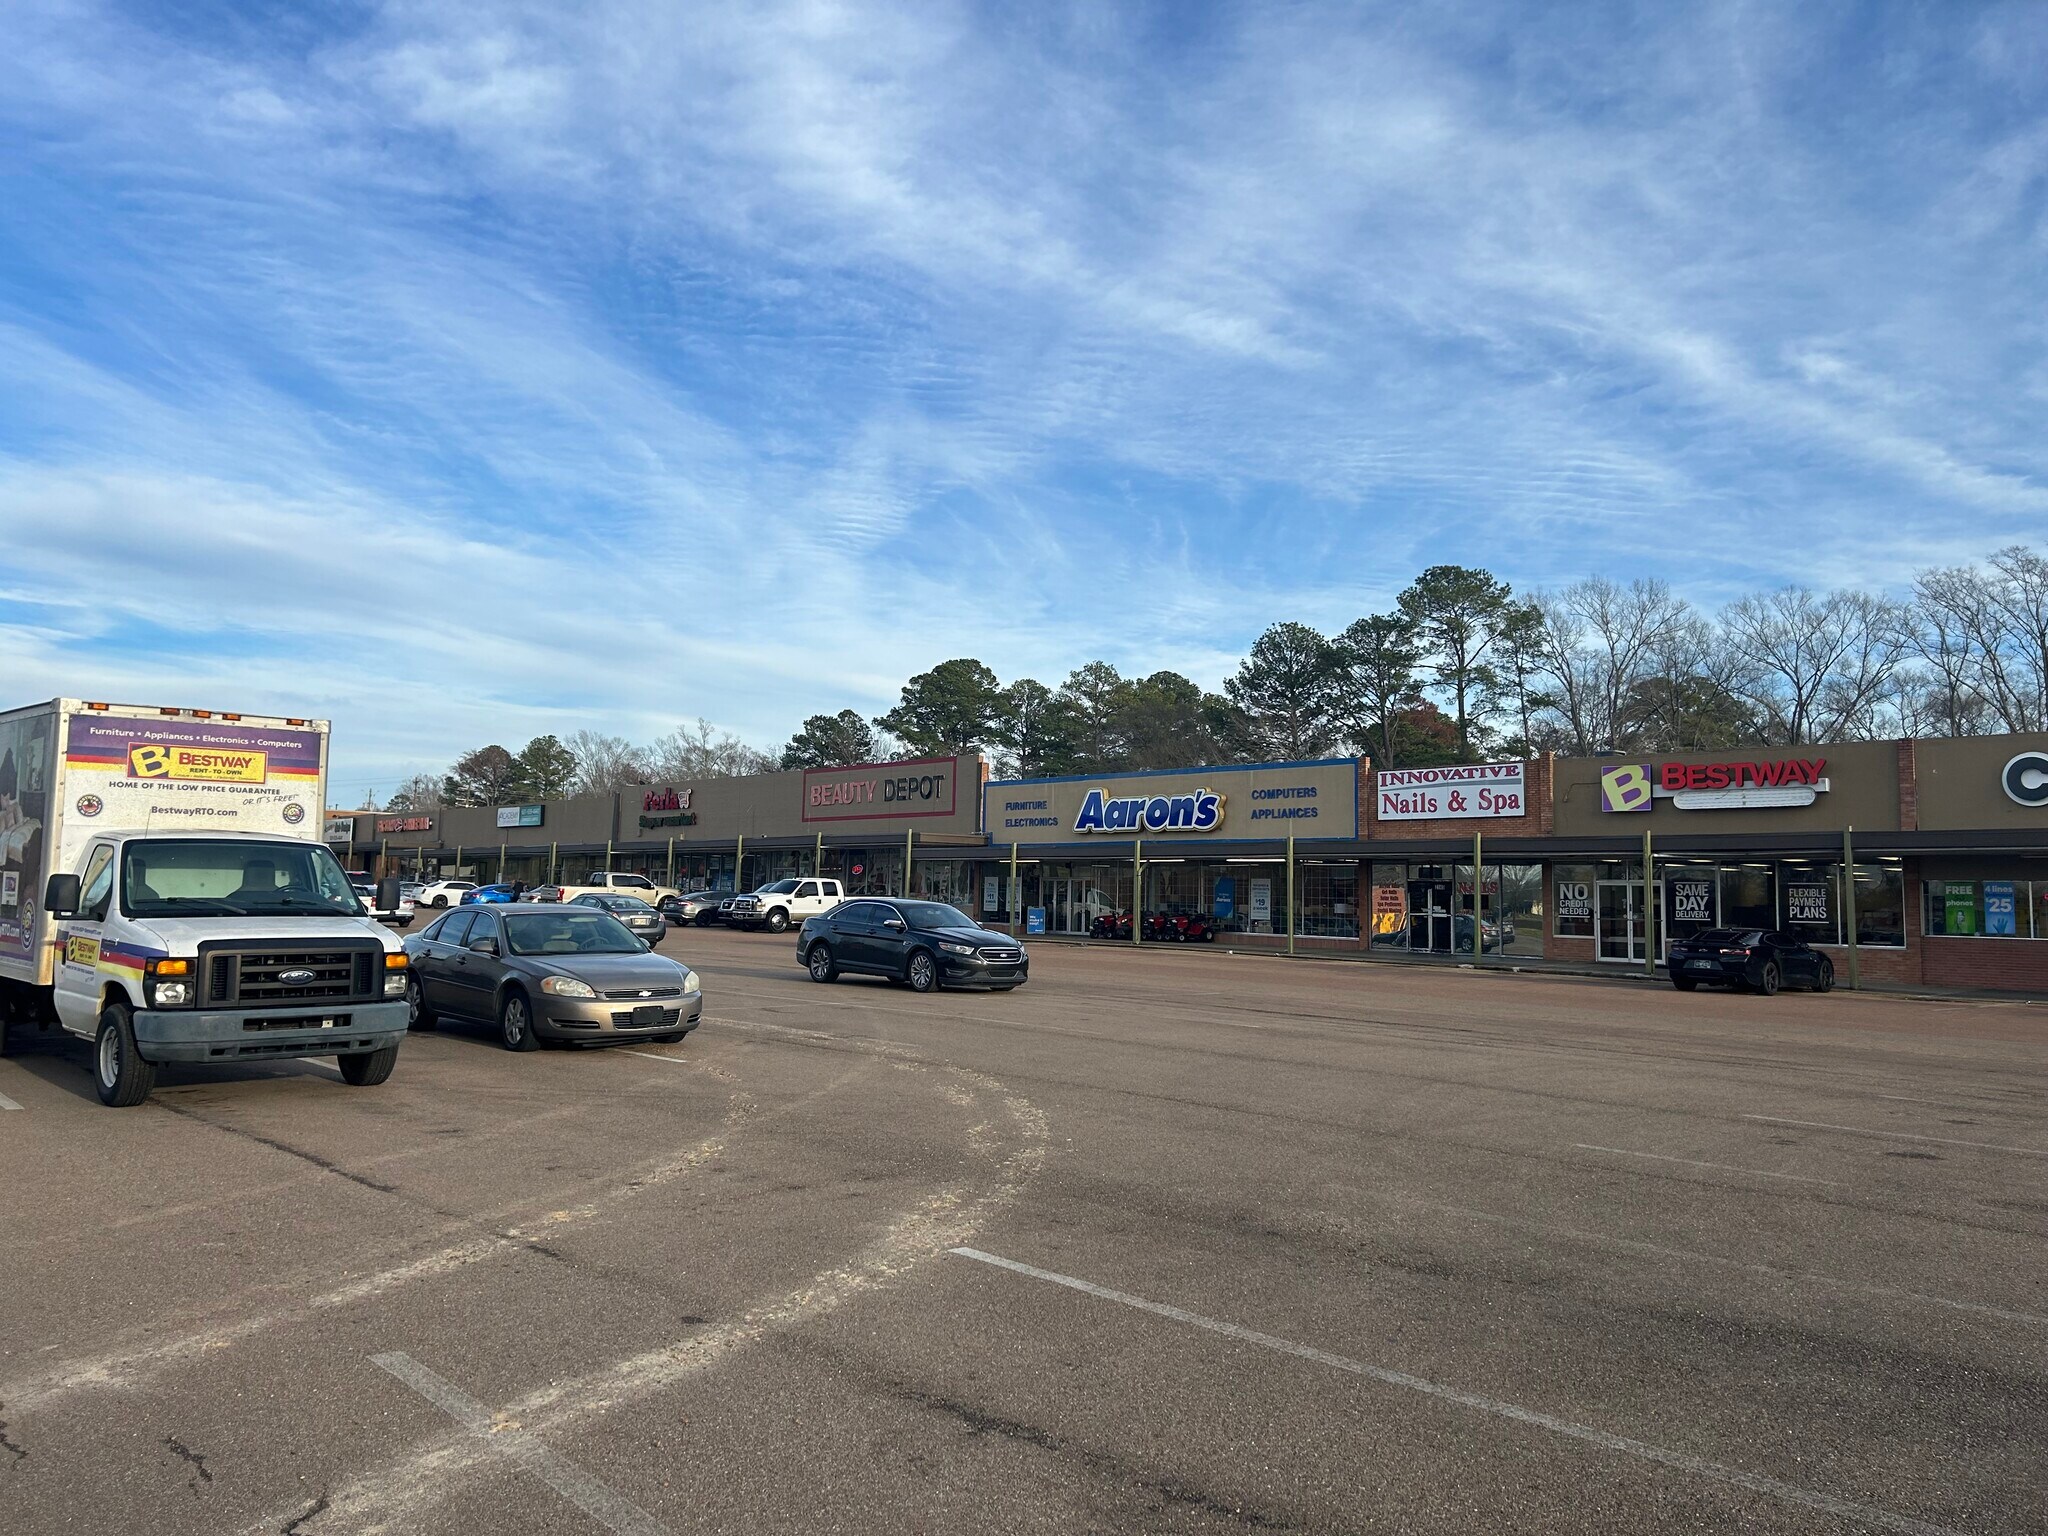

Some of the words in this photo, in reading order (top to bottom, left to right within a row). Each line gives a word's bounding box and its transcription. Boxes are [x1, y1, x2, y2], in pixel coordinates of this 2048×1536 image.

[90, 727, 135, 737] Furniture
[144, 731, 194, 741] Appliances
[202, 735, 249, 745] Electronics
[257, 739, 302, 748] Computers
[131, 746, 170, 777] B
[179, 752, 252, 768] BESTWAY
[1379, 765, 1519, 787] INNOVATIVE
[1661, 759, 1825, 790] BESTWAY
[109, 781, 138, 789] HOME
[201, 785, 226, 793] PRICE
[228, 787, 281, 795] GUARANTEE
[810, 780, 877, 806] BEAUTY
[884, 775, 945, 802] DEPOT
[1251, 786, 1318, 800] COMPUTERS
[643, 787, 679, 811] Perla
[1382, 792, 1438, 814] Nails
[1447, 790, 1467, 812] &
[1478, 788, 1519, 814] Spa
[151, 806, 238, 817] BestwayRTO.com
[1005, 801, 1048, 811] FURNITURE
[1074, 788, 1221, 832] Aaron's
[1251, 807, 1319, 820] APPLIANCES
[1005, 817, 1059, 827] ELECTRONICS
[1458, 881, 1499, 894] NALS
[1559, 883, 1589, 900] NO
[1675, 884, 1709, 896] SAME
[1788, 888, 1826, 897] FLEXIBLE
[1945, 885, 1973, 895] FREE
[1992, 885, 2013, 893] lines
[1559, 899, 1588, 908] CREDIT
[1675, 896, 1709, 910] DAY
[1789, 897, 1826, 907] PAYMENT
[1946, 899, 1974, 907] phones
[1985, 897, 2012, 913] $25
[1559, 907, 1589, 915] NEEDED
[1675, 910, 1709, 918] DELIVERY
[1789, 906, 1827, 919] PLANS
